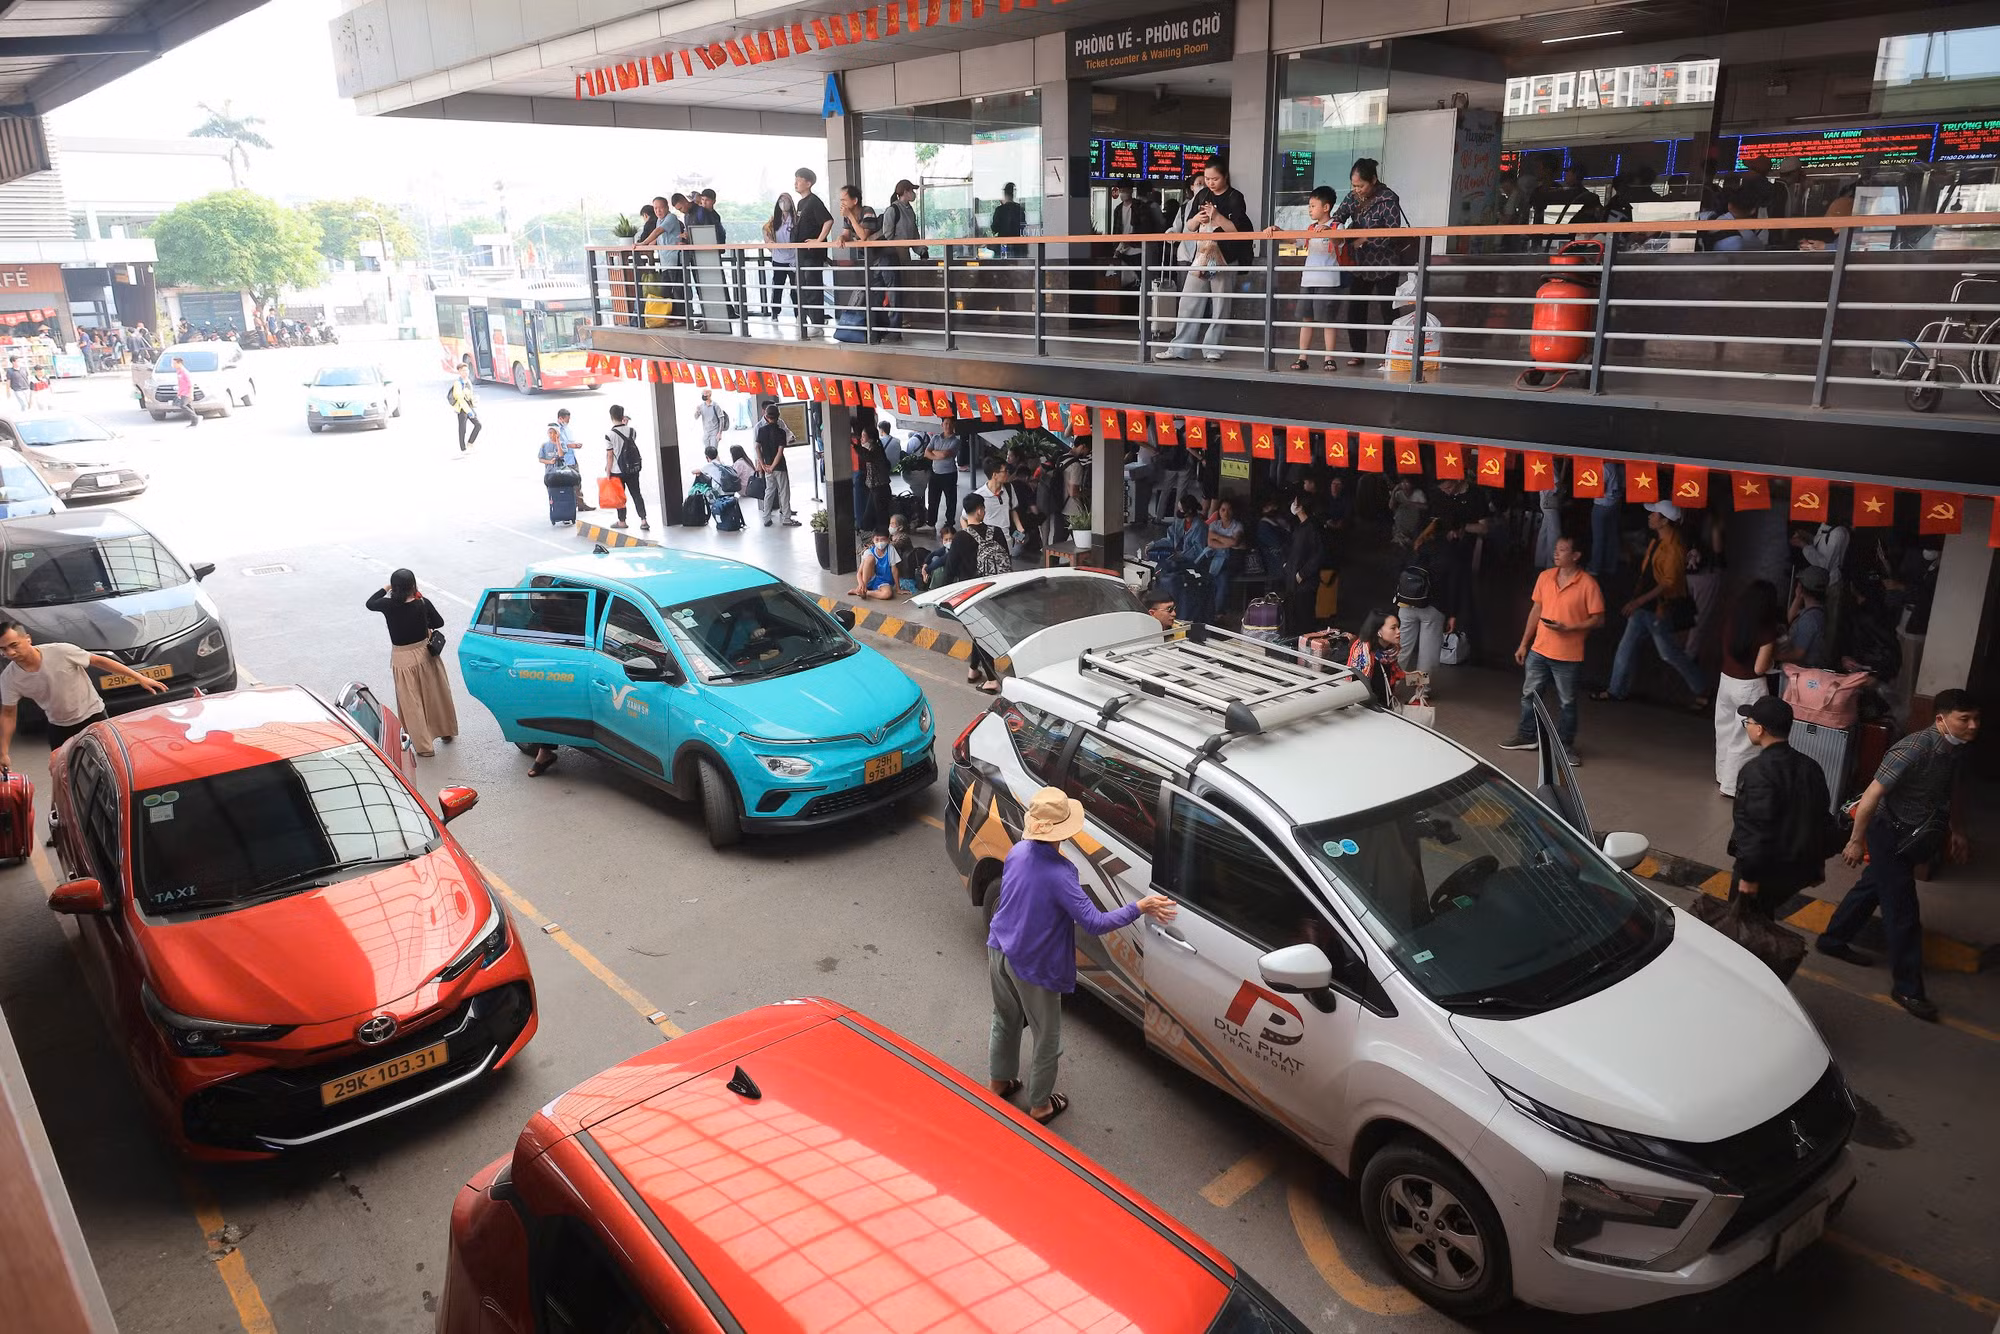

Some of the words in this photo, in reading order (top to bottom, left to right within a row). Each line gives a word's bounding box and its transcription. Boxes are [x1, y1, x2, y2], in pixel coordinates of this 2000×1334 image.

[1075, 34, 1114, 56] PHÒNG
[1117, 27, 1133, 49] VÉ
[1145, 21, 1188, 45] PHÒNG
[1192, 12, 1221, 36] CHỜ
[1085, 59, 1109, 70] Ticket
[1110, 54, 1139, 66] counter
[1141, 52, 1148, 61] &
[1150, 47, 1181, 60] Waiting
[1183, 42, 1209, 55] Room
[822, 72, 845, 118] A
[0, 266, 30, 288] FÉ
[107, 668, 167, 687] 29K-1.80
[519, 670, 544, 680] 1900
[154, 885, 197, 903] TAXI
[1214, 1016, 1251, 1045] DUC
[1258, 1040, 1305, 1071] PHAT
[1222, 1032, 1295, 1077] TRANSPORT
[333, 1050, 437, 1099] 29K-103.31
